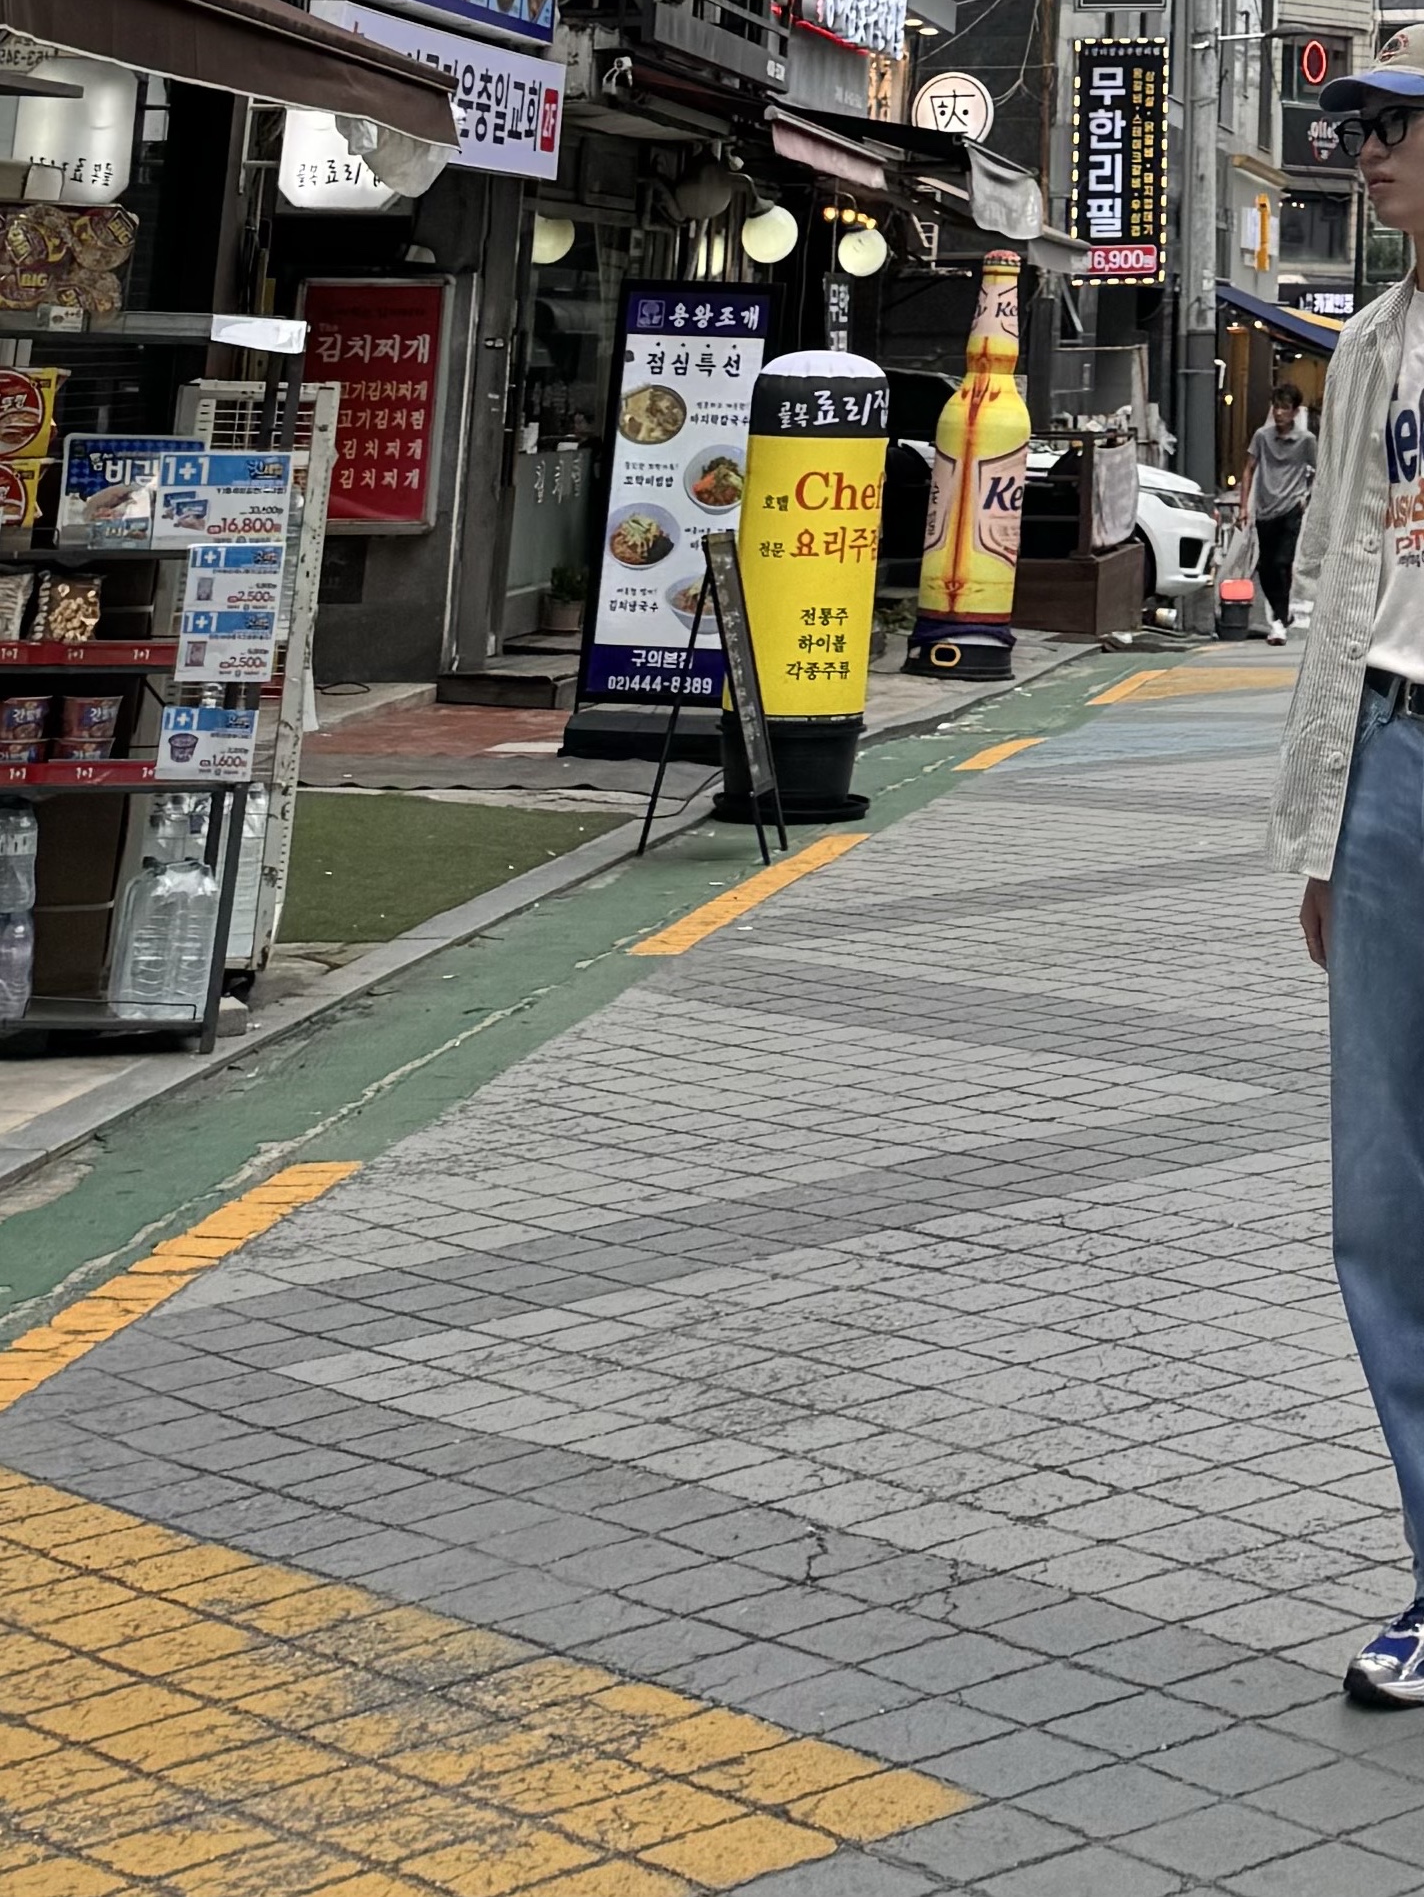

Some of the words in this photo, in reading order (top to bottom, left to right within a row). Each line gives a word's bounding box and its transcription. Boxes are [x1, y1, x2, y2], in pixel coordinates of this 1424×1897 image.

[1086, 67, 1126, 238] 무한리필
[21, 272, 47, 287] BIG
[668, 303, 760, 331] 용왕조개
[316, 333, 431, 364] 김치찌개
[645, 351, 742, 378] 점심특선
